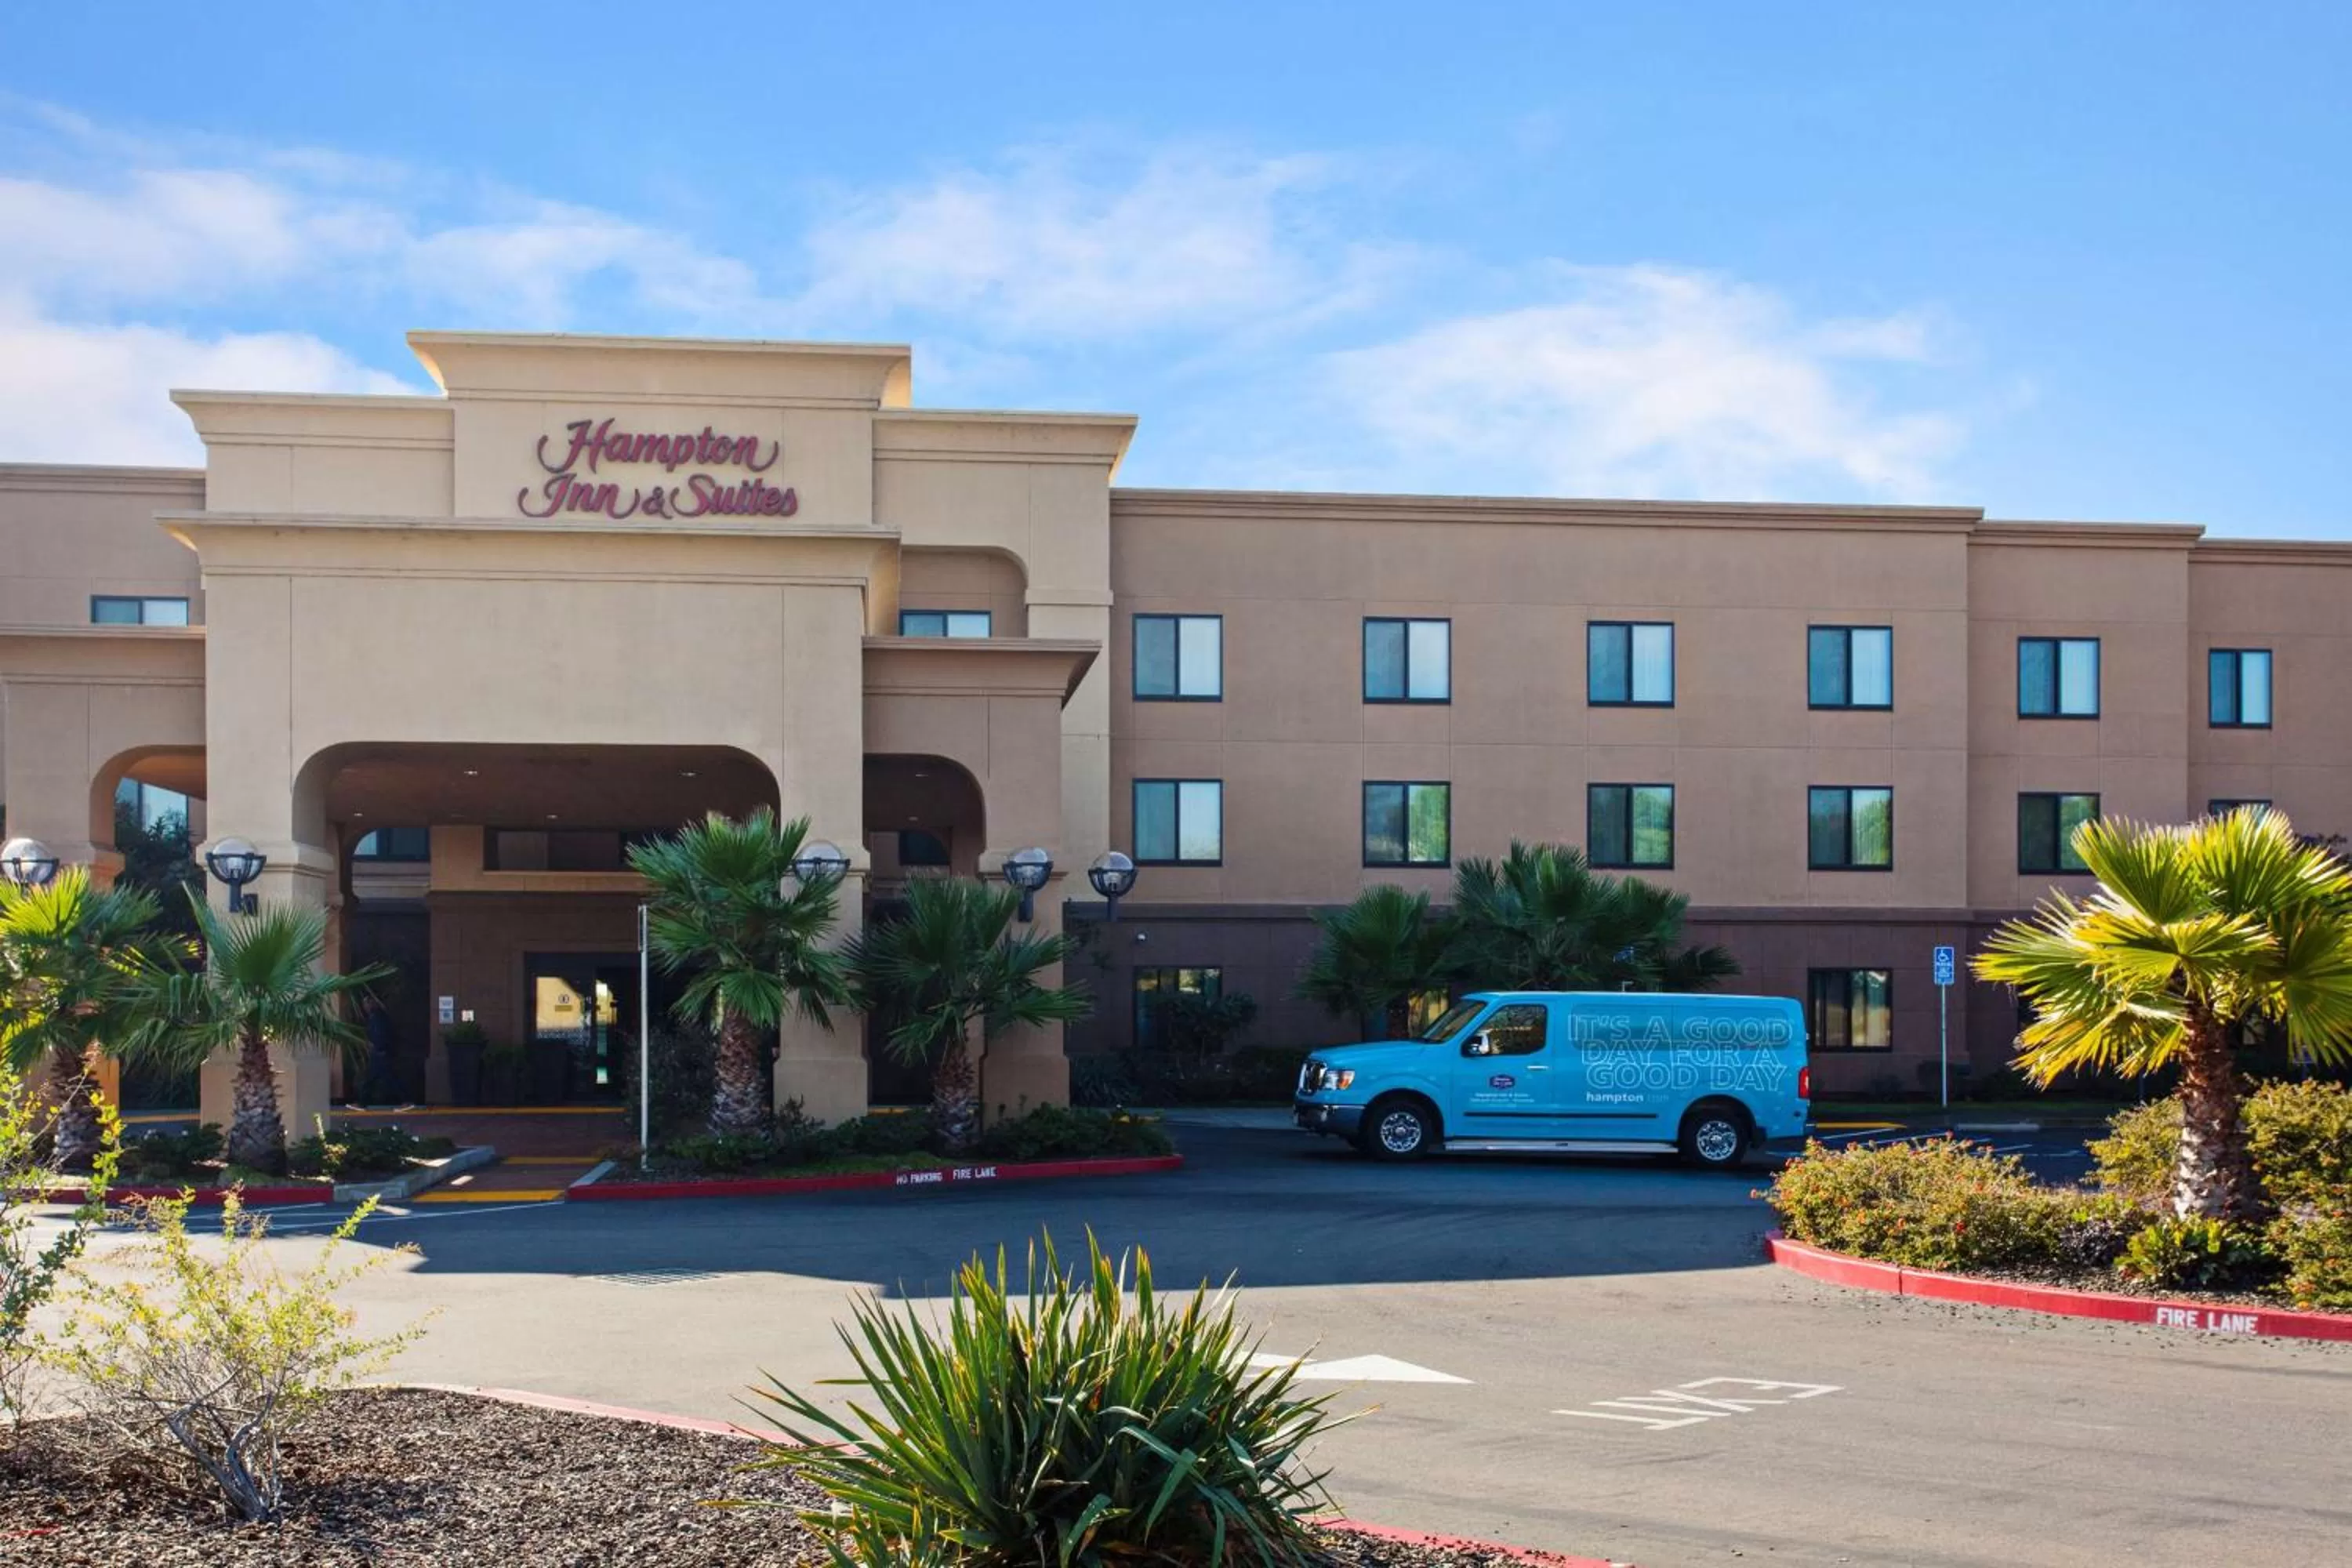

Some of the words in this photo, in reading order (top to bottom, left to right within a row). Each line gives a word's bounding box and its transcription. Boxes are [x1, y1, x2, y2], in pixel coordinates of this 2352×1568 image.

[537, 418, 779, 474] Hampton
[517, 473, 641, 519] Inn
[641, 486, 673, 519] &
[670, 474, 798, 517] Suites
[1569, 1014, 1631, 1041] IT'S
[1643, 1016, 1671, 1042] A
[1682, 1017, 1793, 1044] GOOD
[1581, 1040, 1660, 1065] DAY
[1671, 1040, 1741, 1066] FOR
[1753, 1043, 1781, 1066] A
[1586, 1063, 1699, 1089] GOOD
[1710, 1065, 1788, 1091] DAY
[1586, 1091, 1644, 1104] hampton
[910, 1171, 943, 1184] PARKING
[953, 1168, 971, 1179] FIRE
[975, 1167, 997, 1178] LANE
[2157, 1307, 2199, 1328] FIRE
[2207, 1312, 2259, 1334] LANE
